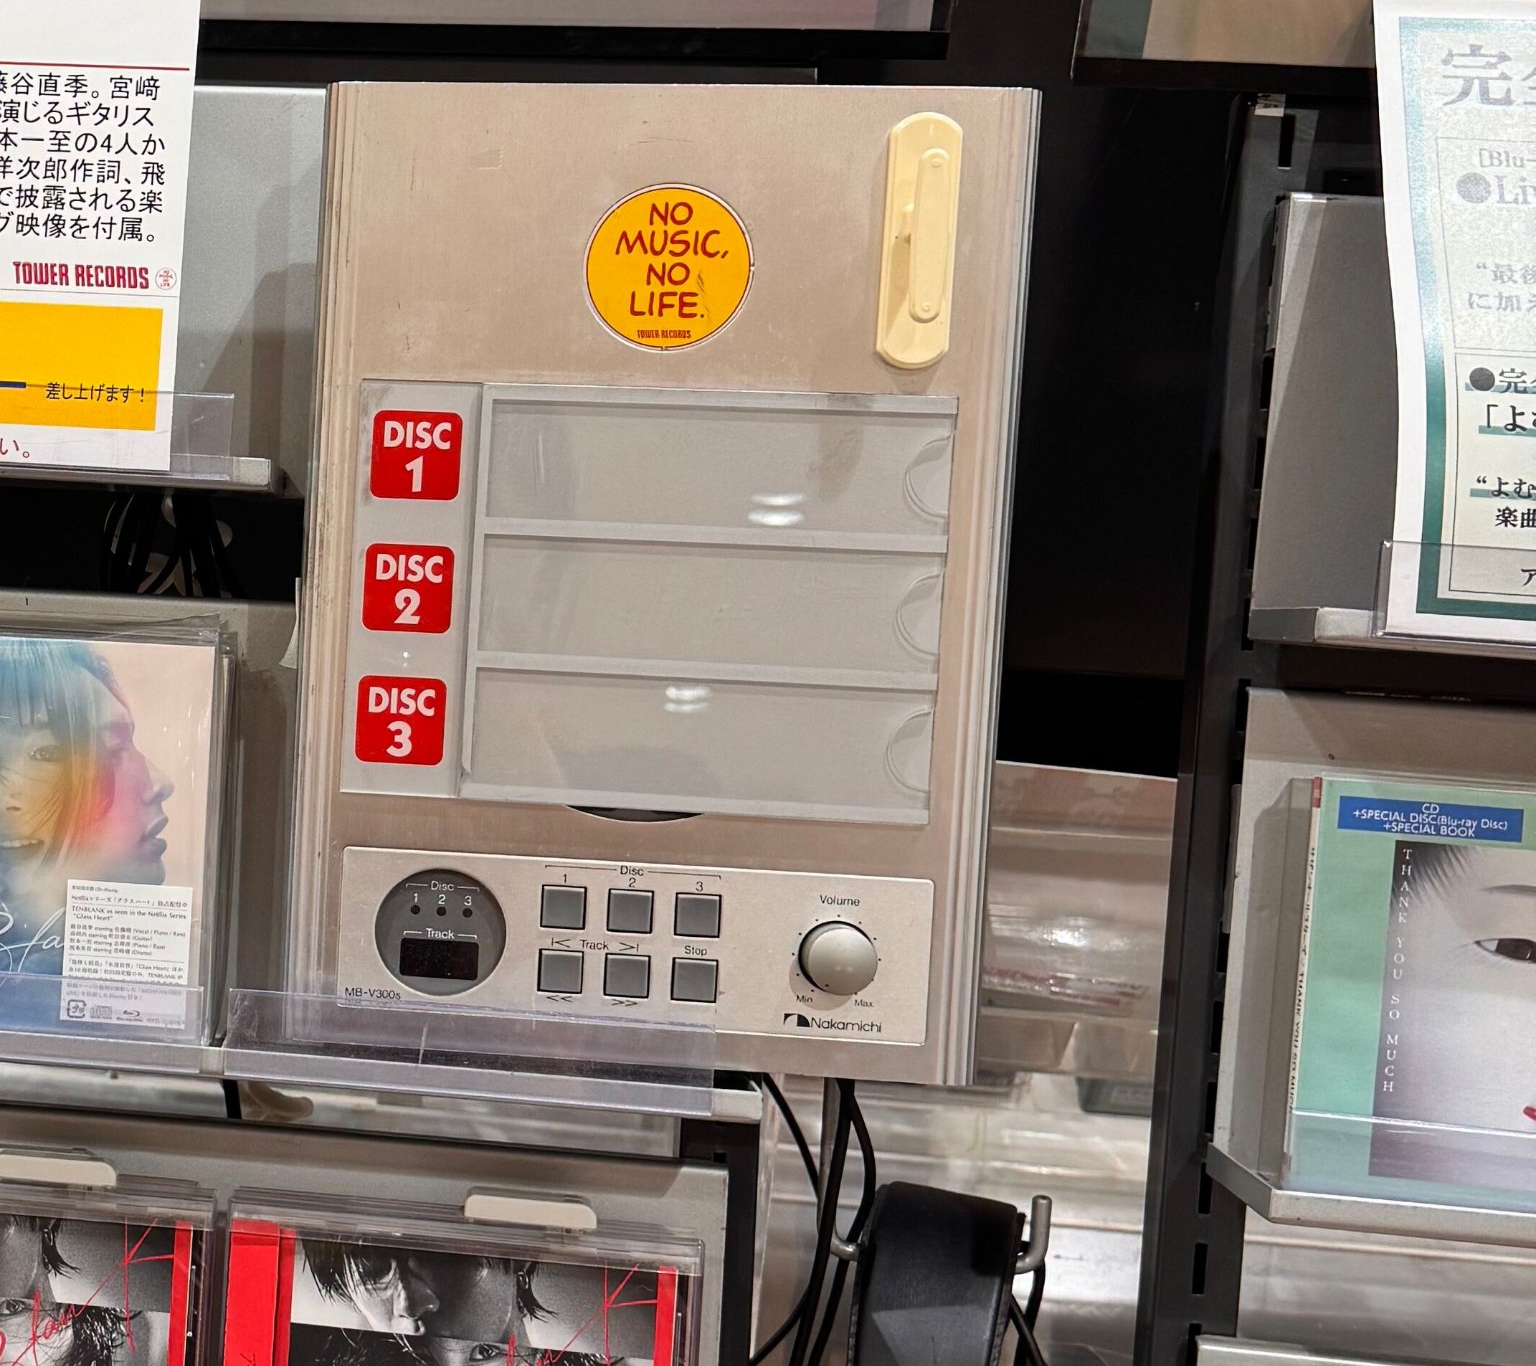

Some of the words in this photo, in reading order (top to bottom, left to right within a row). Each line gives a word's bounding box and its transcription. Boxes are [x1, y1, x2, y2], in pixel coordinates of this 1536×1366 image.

[648, 200, 693, 228] NO
[614, 229, 729, 261] MUSIC,
[13, 261, 70, 286] TOWER
[75, 263, 149, 290] RECORDS
[644, 261, 691, 289] NO
[628, 289, 705, 320] LIFE.
[45, 382, 145, 404] 差し上げます！
[382, 421, 452, 452] DISC
[403, 458, 425, 496] 1
[375, 553, 444, 585] DISC
[393, 591, 420, 628] 2
[367, 686, 436, 718] DISC
[386, 722, 414, 760] 3
[1422, 803, 1440, 814] CD
[818, 893, 860, 907] Volume
[1397, 848, 1413, 924] THANK
[1392, 937, 1405, 981] YOU
[1389, 994, 1400, 1021] SO
[809, 1012, 882, 1036] Nakamichi
[1383, 1034, 1399, 1093] MUCH
